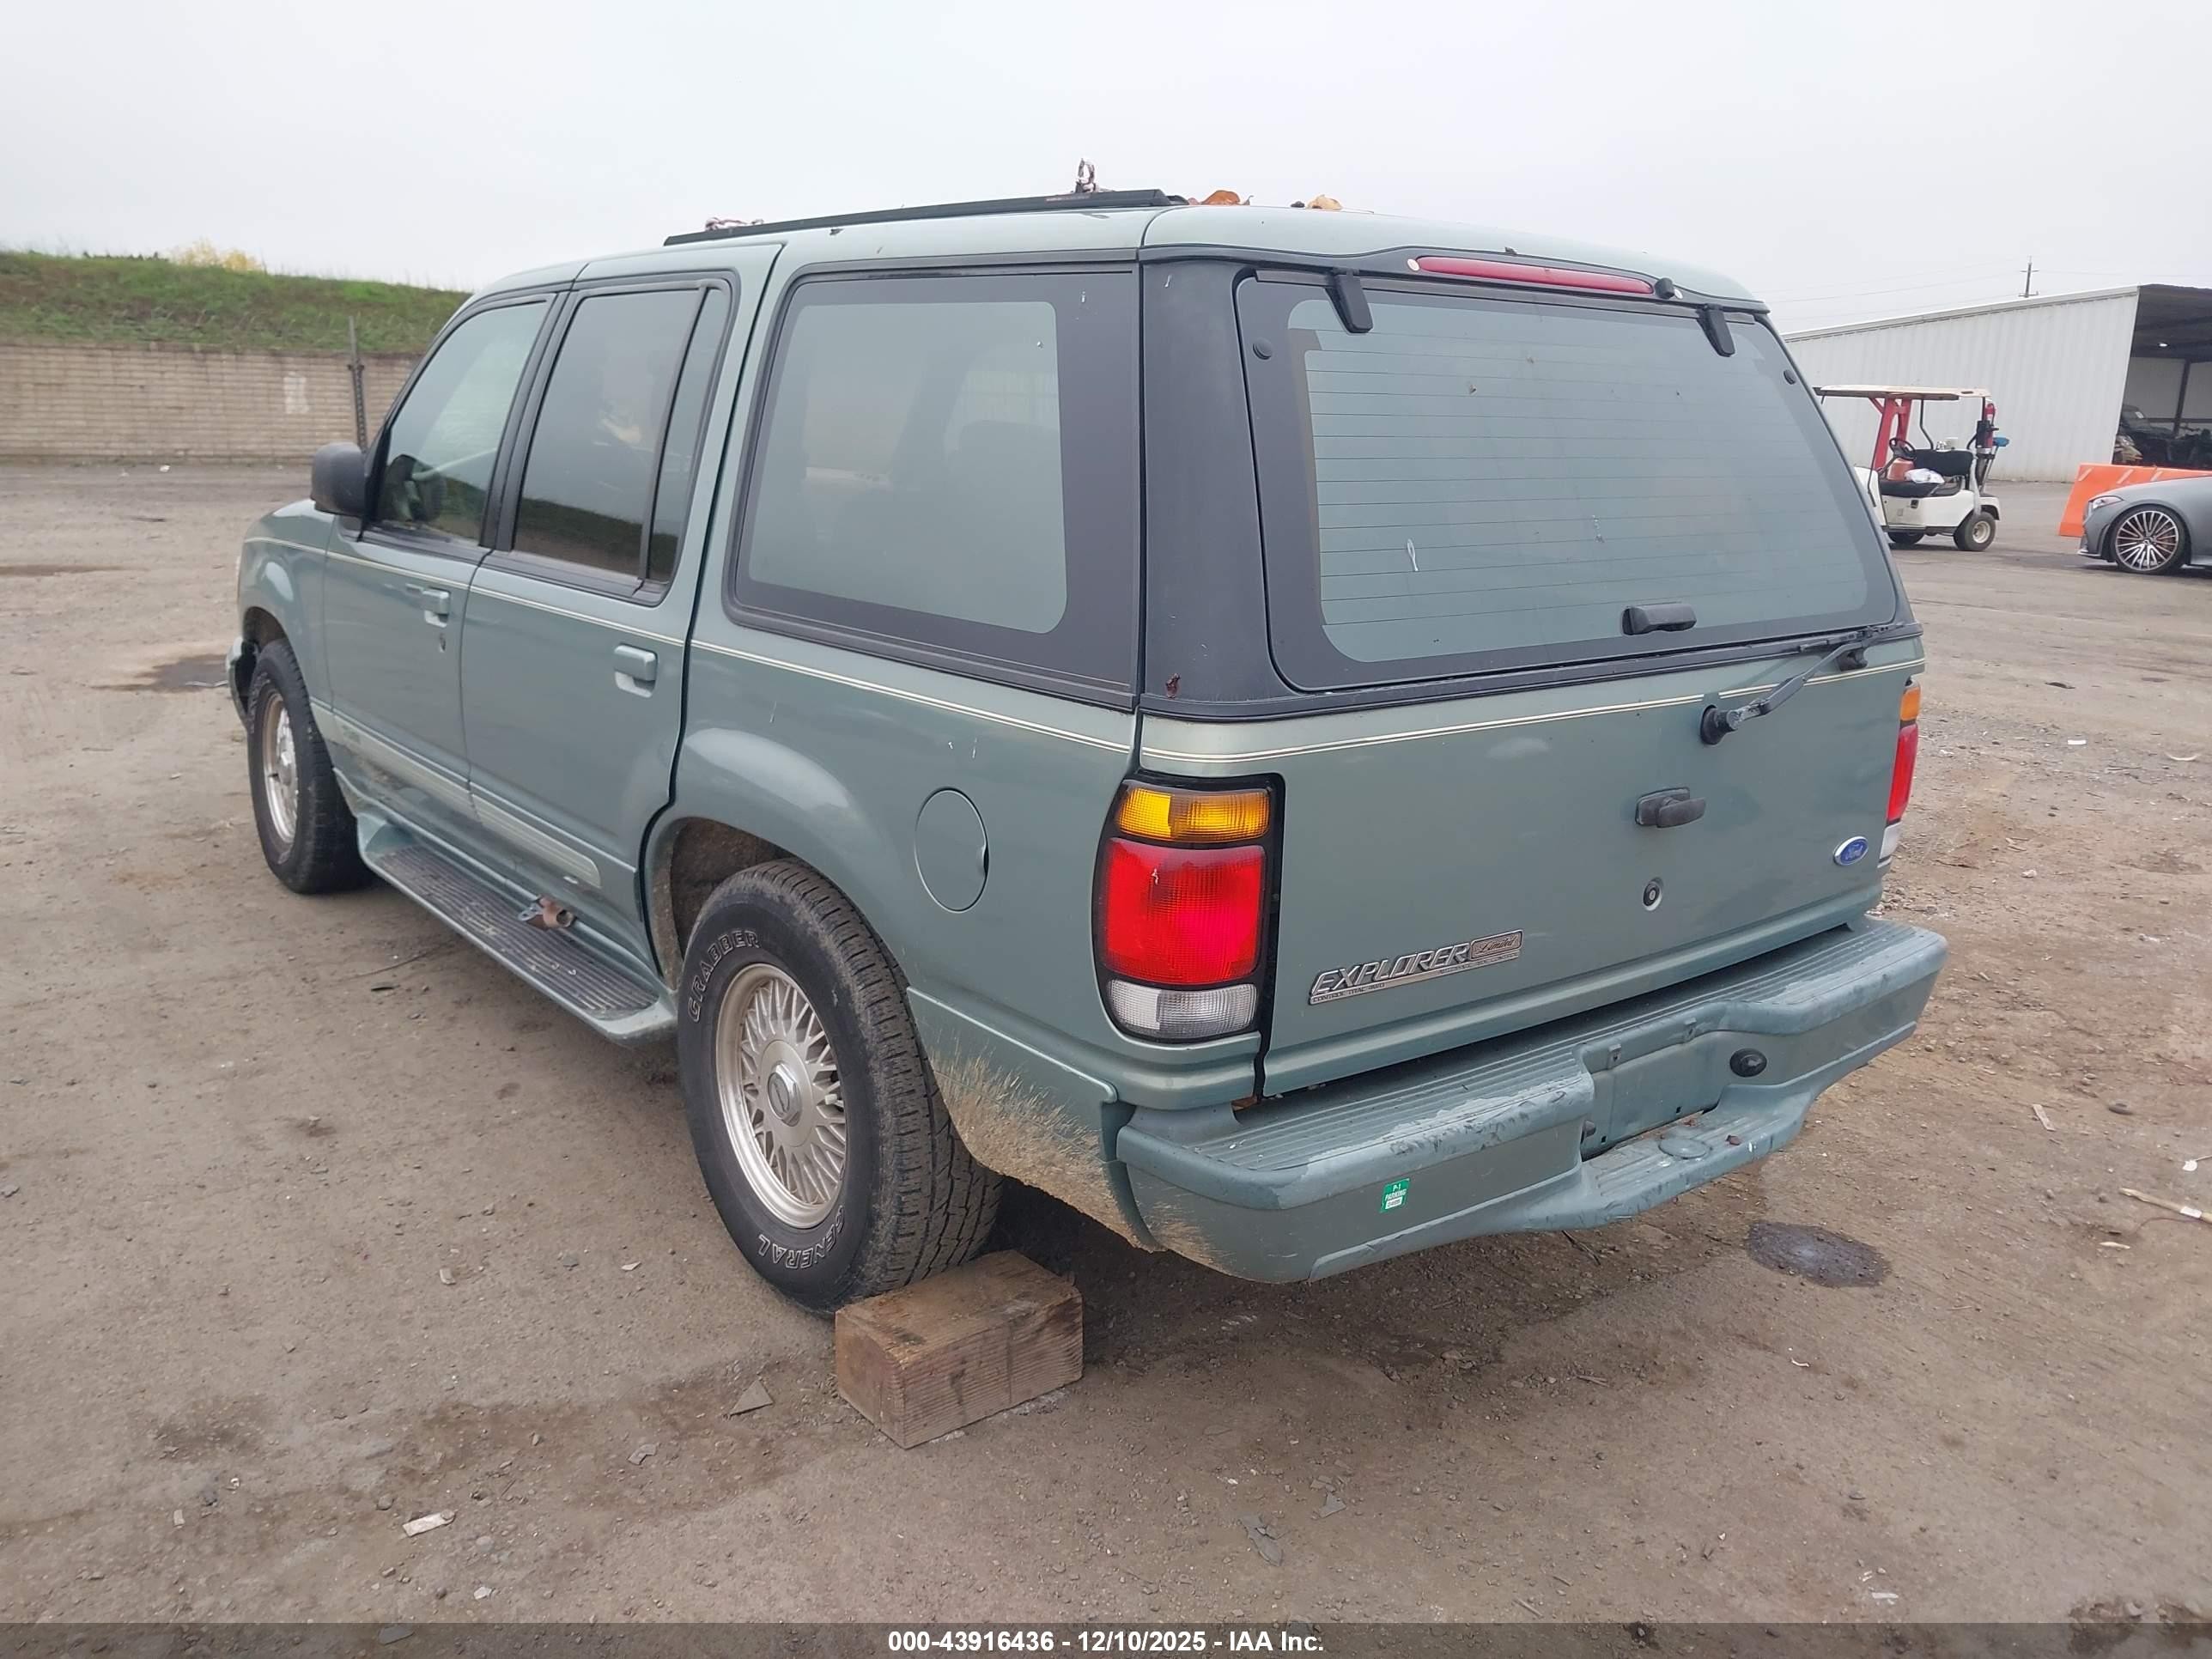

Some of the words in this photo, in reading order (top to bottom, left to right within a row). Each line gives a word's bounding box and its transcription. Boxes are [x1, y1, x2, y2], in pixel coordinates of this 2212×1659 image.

[688, 929, 759, 1023] GRABBER
[1311, 942, 1469, 995] EXPLORER
[1476, 934, 1518, 953] Limited
[758, 1205, 845, 1269] GENERAL
